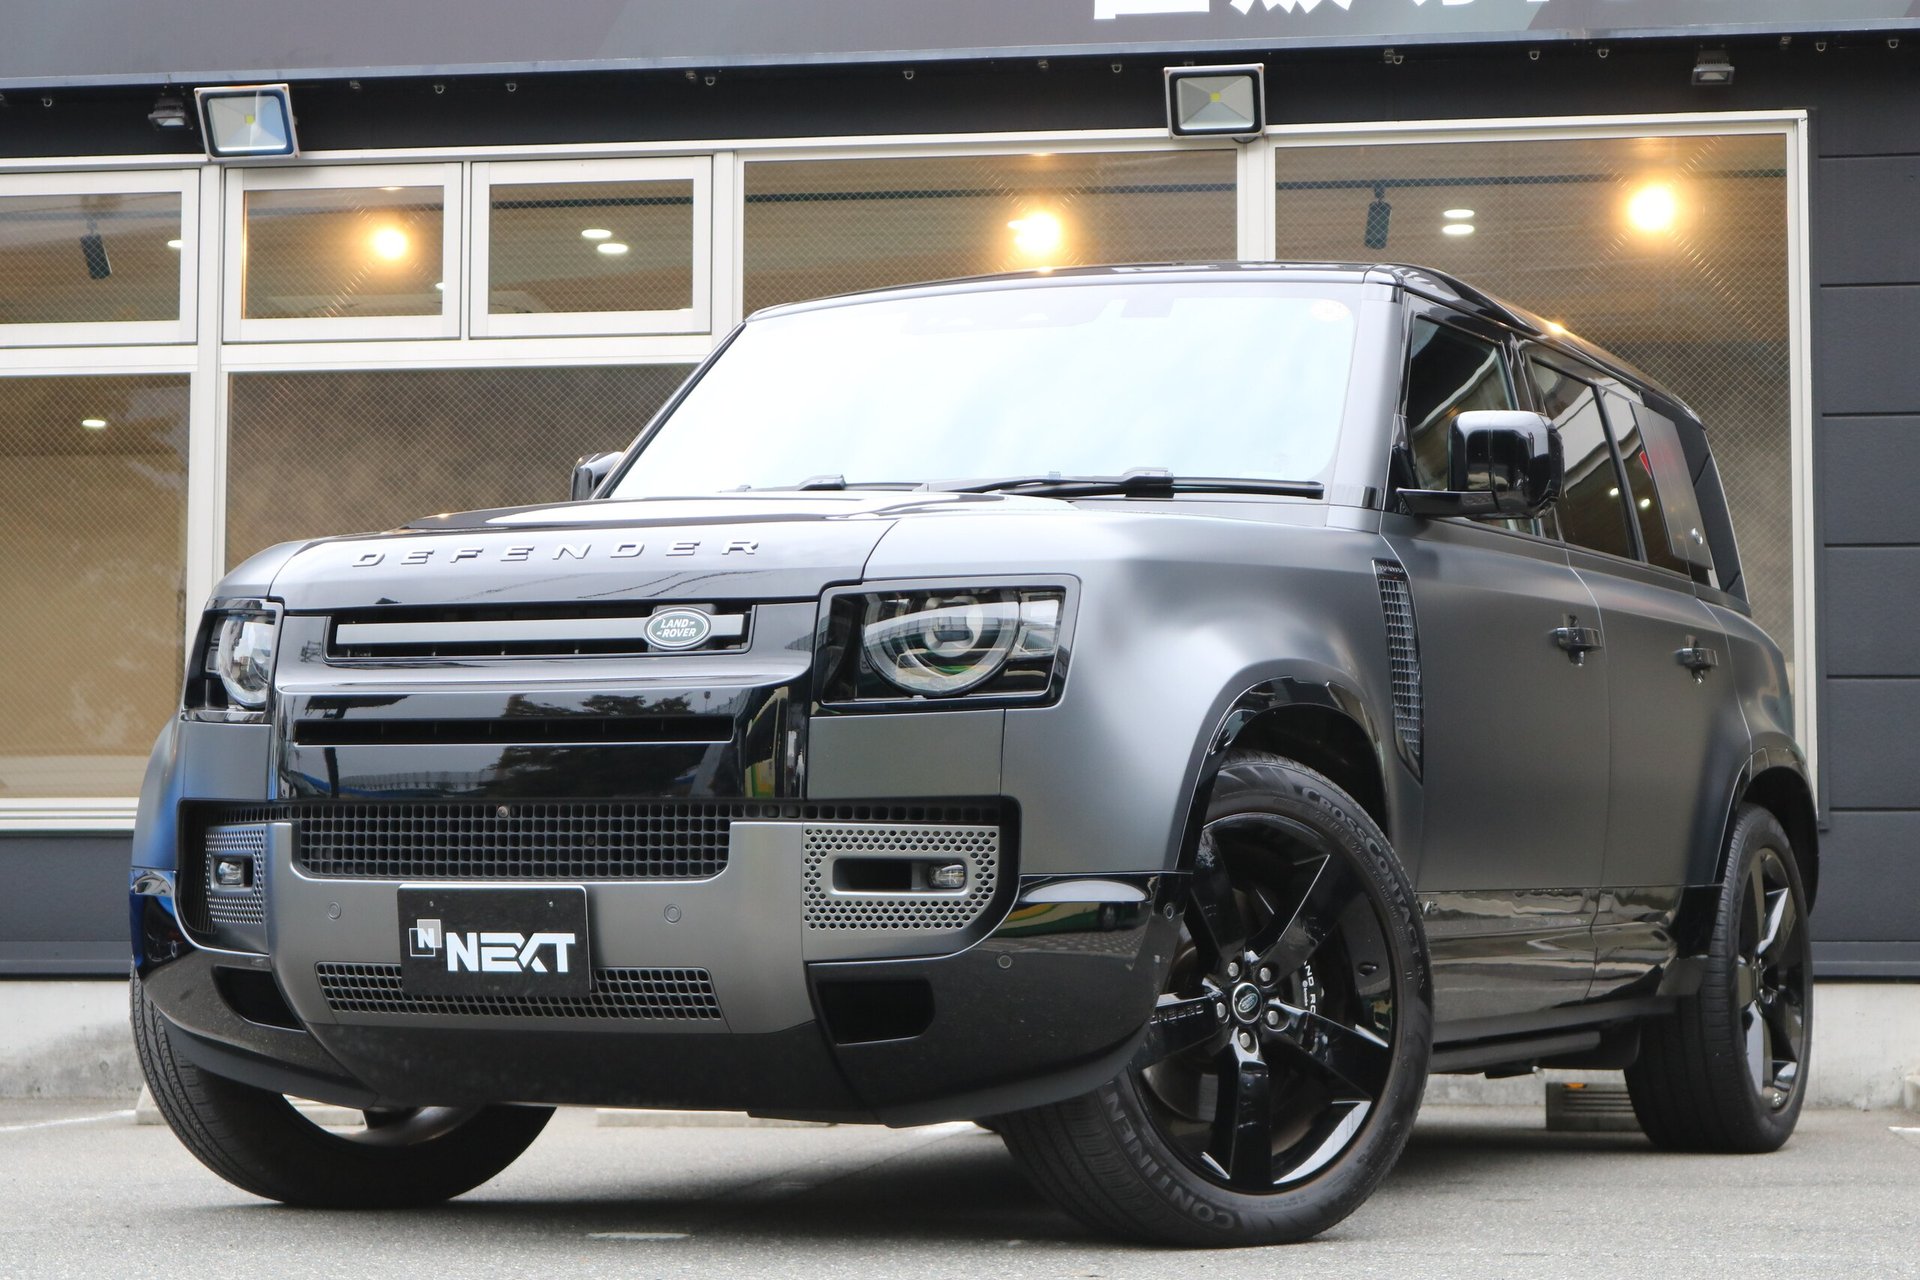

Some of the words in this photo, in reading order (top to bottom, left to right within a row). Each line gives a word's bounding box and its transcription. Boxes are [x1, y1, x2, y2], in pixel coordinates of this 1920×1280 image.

[352, 540, 759, 568] DEFENDER
[445, 932, 576, 973] NEXT
[1103, 1081, 1235, 1230] CONTINEN
